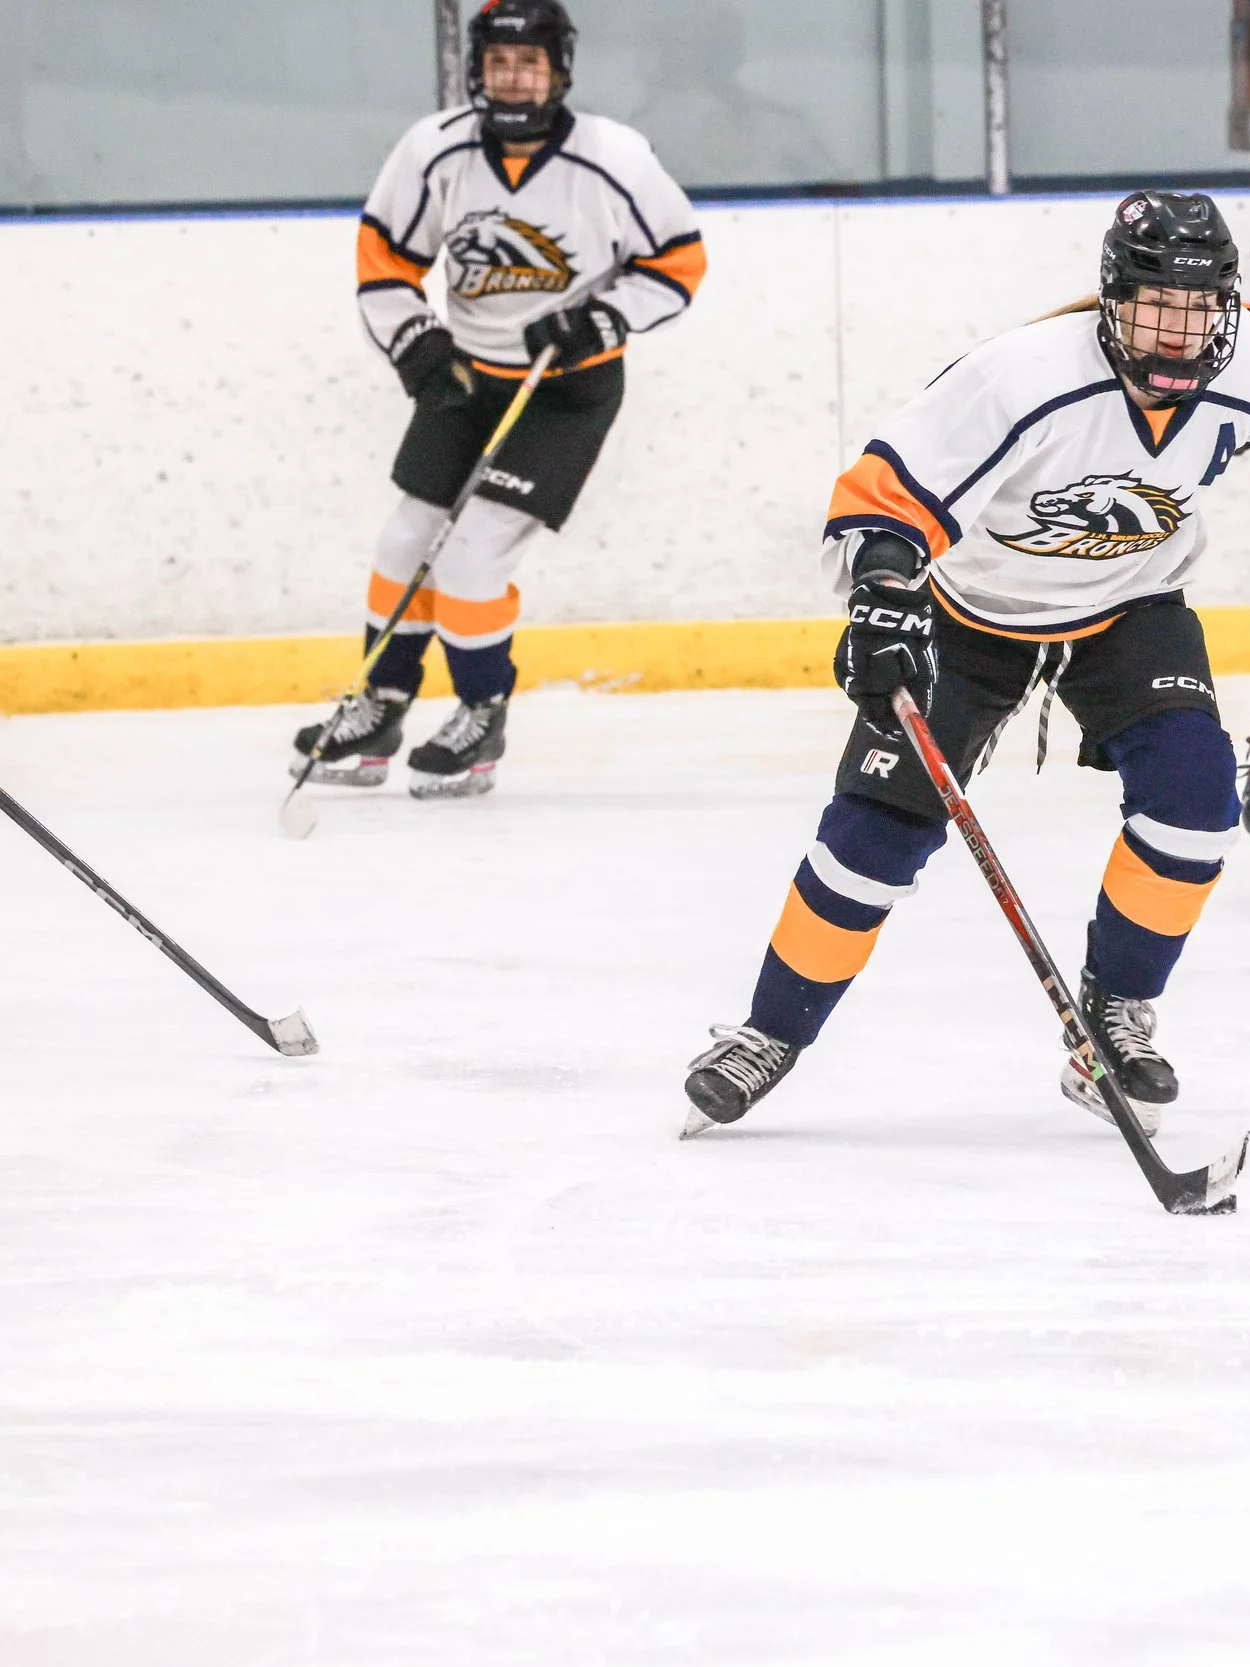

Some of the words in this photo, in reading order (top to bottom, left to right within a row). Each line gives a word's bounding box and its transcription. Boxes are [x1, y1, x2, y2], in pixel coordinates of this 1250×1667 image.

[1173, 256, 1213, 267] CCM
[1198, 421, 1236, 486] A
[1001, 523, 1161, 558] BRONCOS
[850, 605, 933, 636] CCM
[1151, 676, 1216, 702] CCM
[937, 783, 1001, 892] JETSPEED
